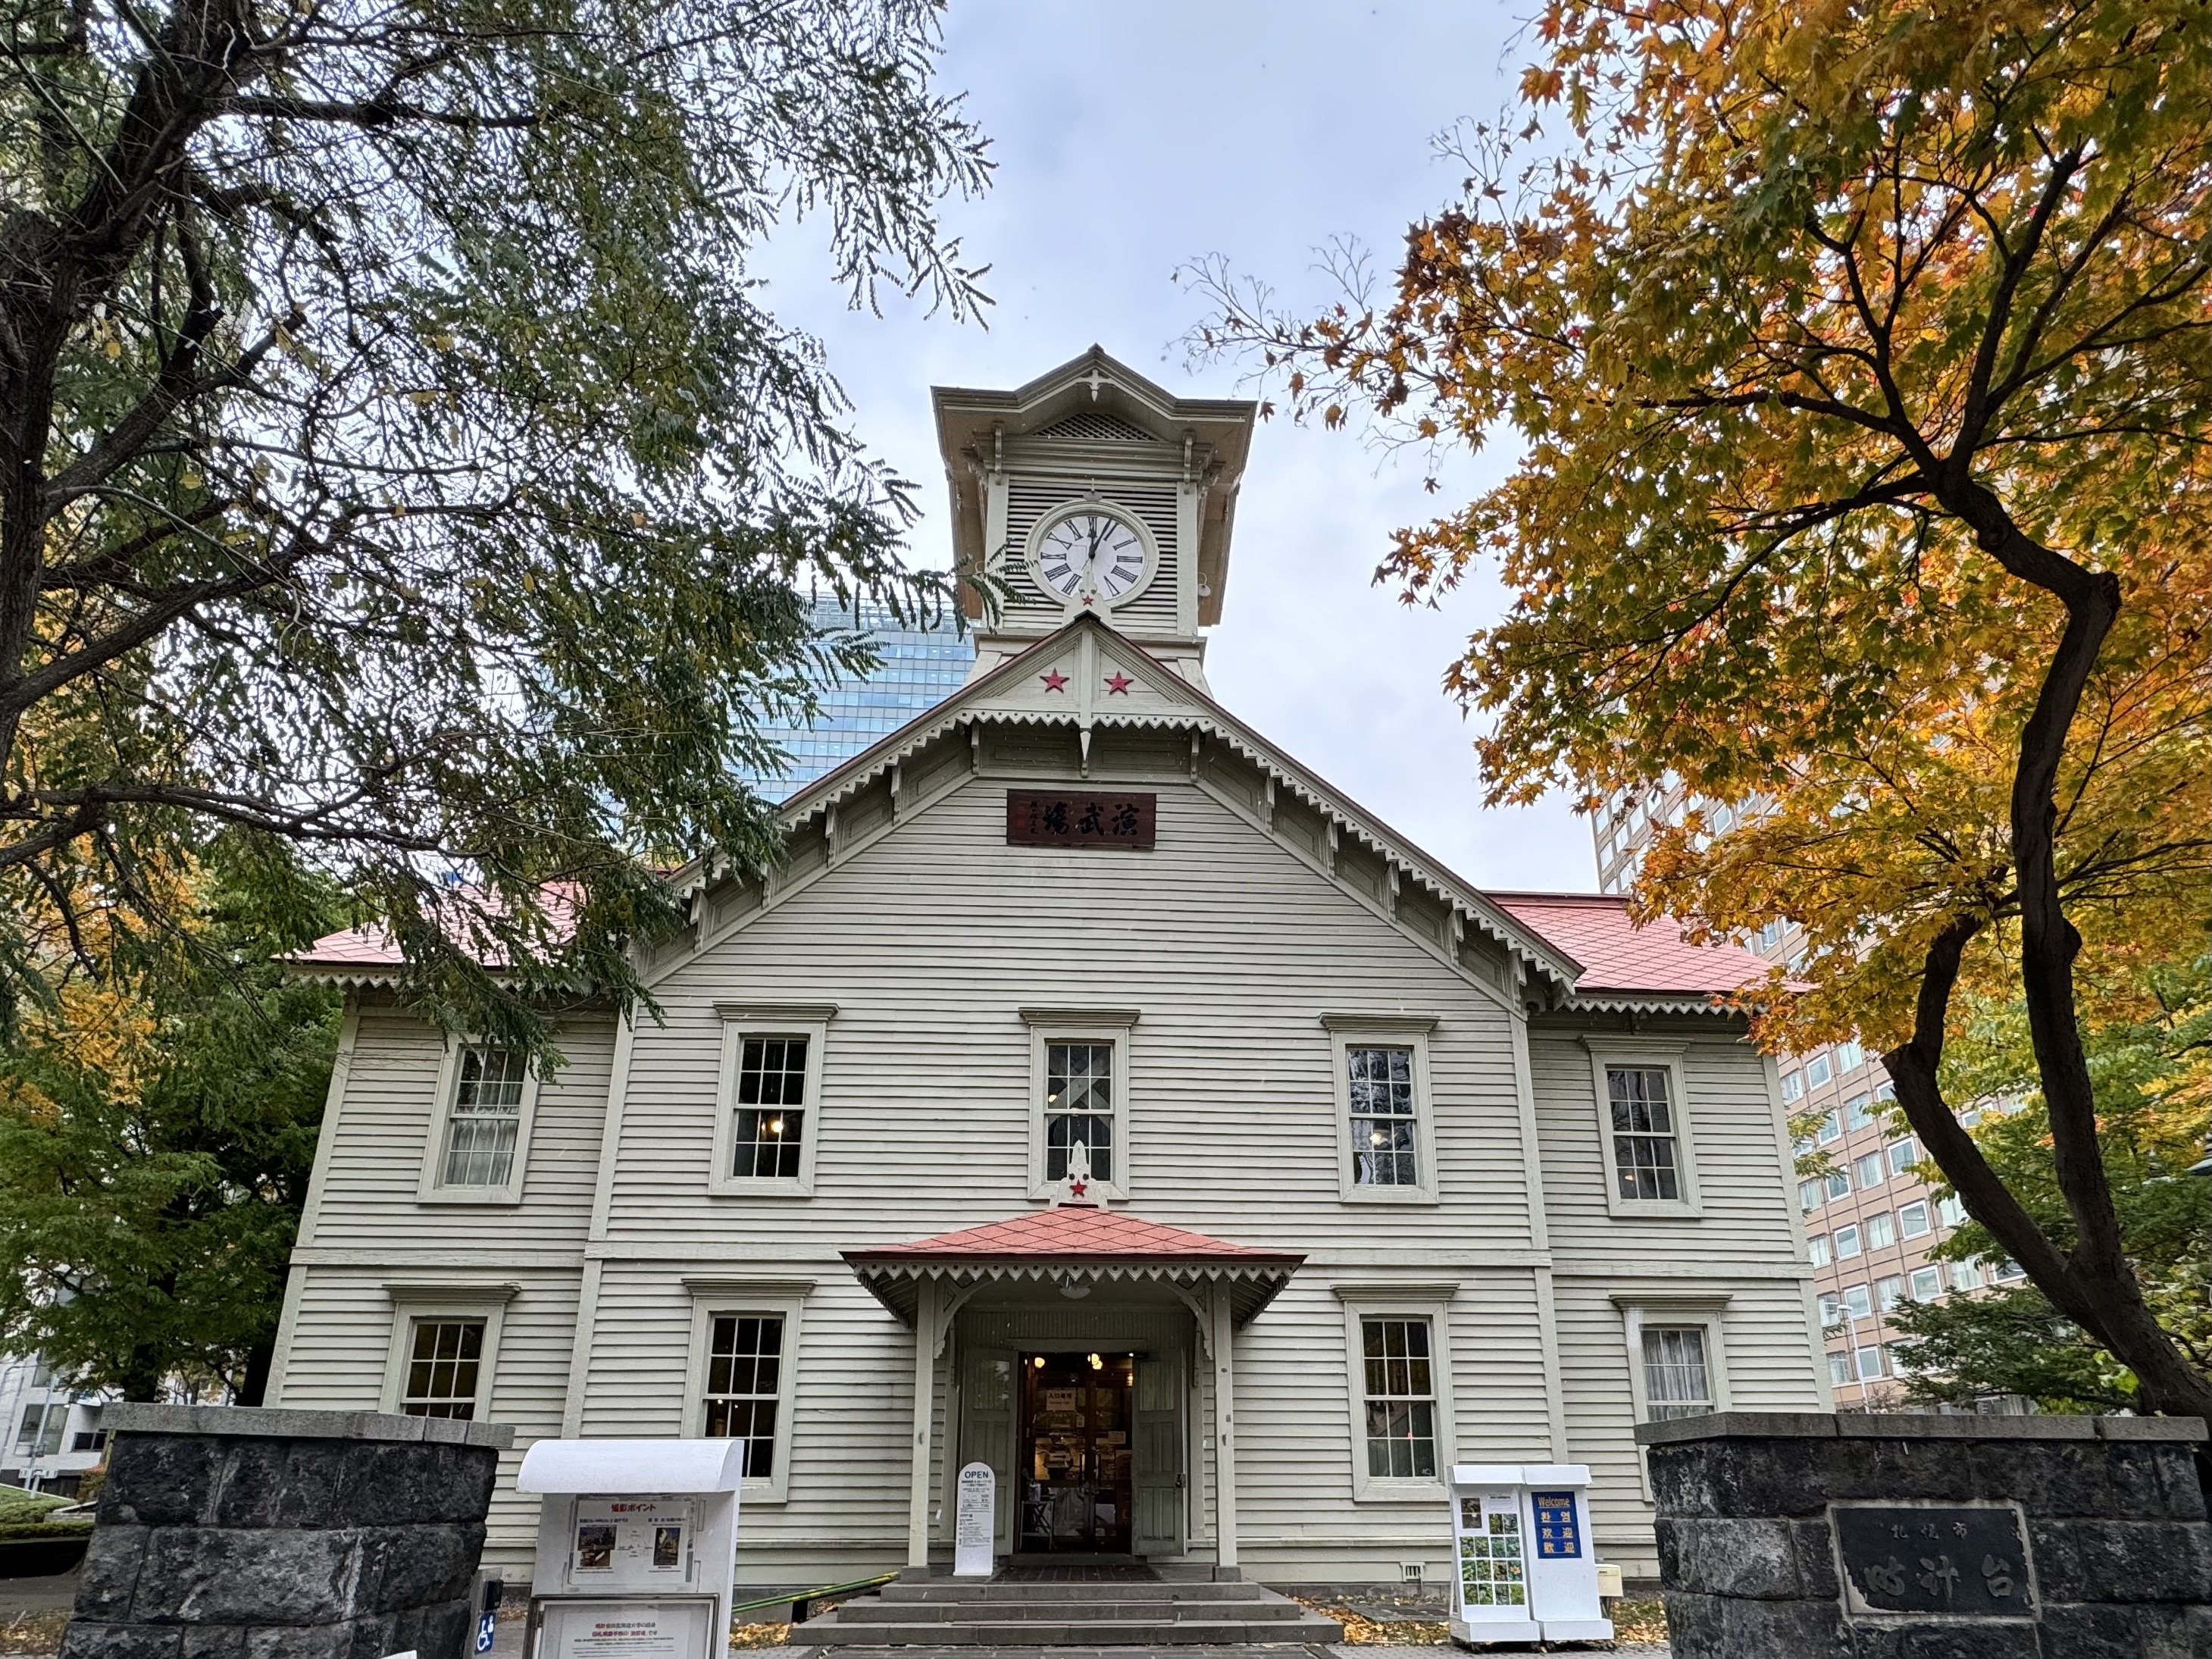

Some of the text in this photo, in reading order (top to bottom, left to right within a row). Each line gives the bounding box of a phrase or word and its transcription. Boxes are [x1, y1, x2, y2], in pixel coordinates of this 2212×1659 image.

[1046, 532, 1072, 550] X
[1112, 537, 1137, 550] II
[1040, 552, 1067, 560] IX
[1116, 555, 1144, 564] III
[1103, 575, 1121, 596] V
[1538, 1496, 1571, 1507] Welcome
[1863, 1554, 2014, 1602] 時計台
